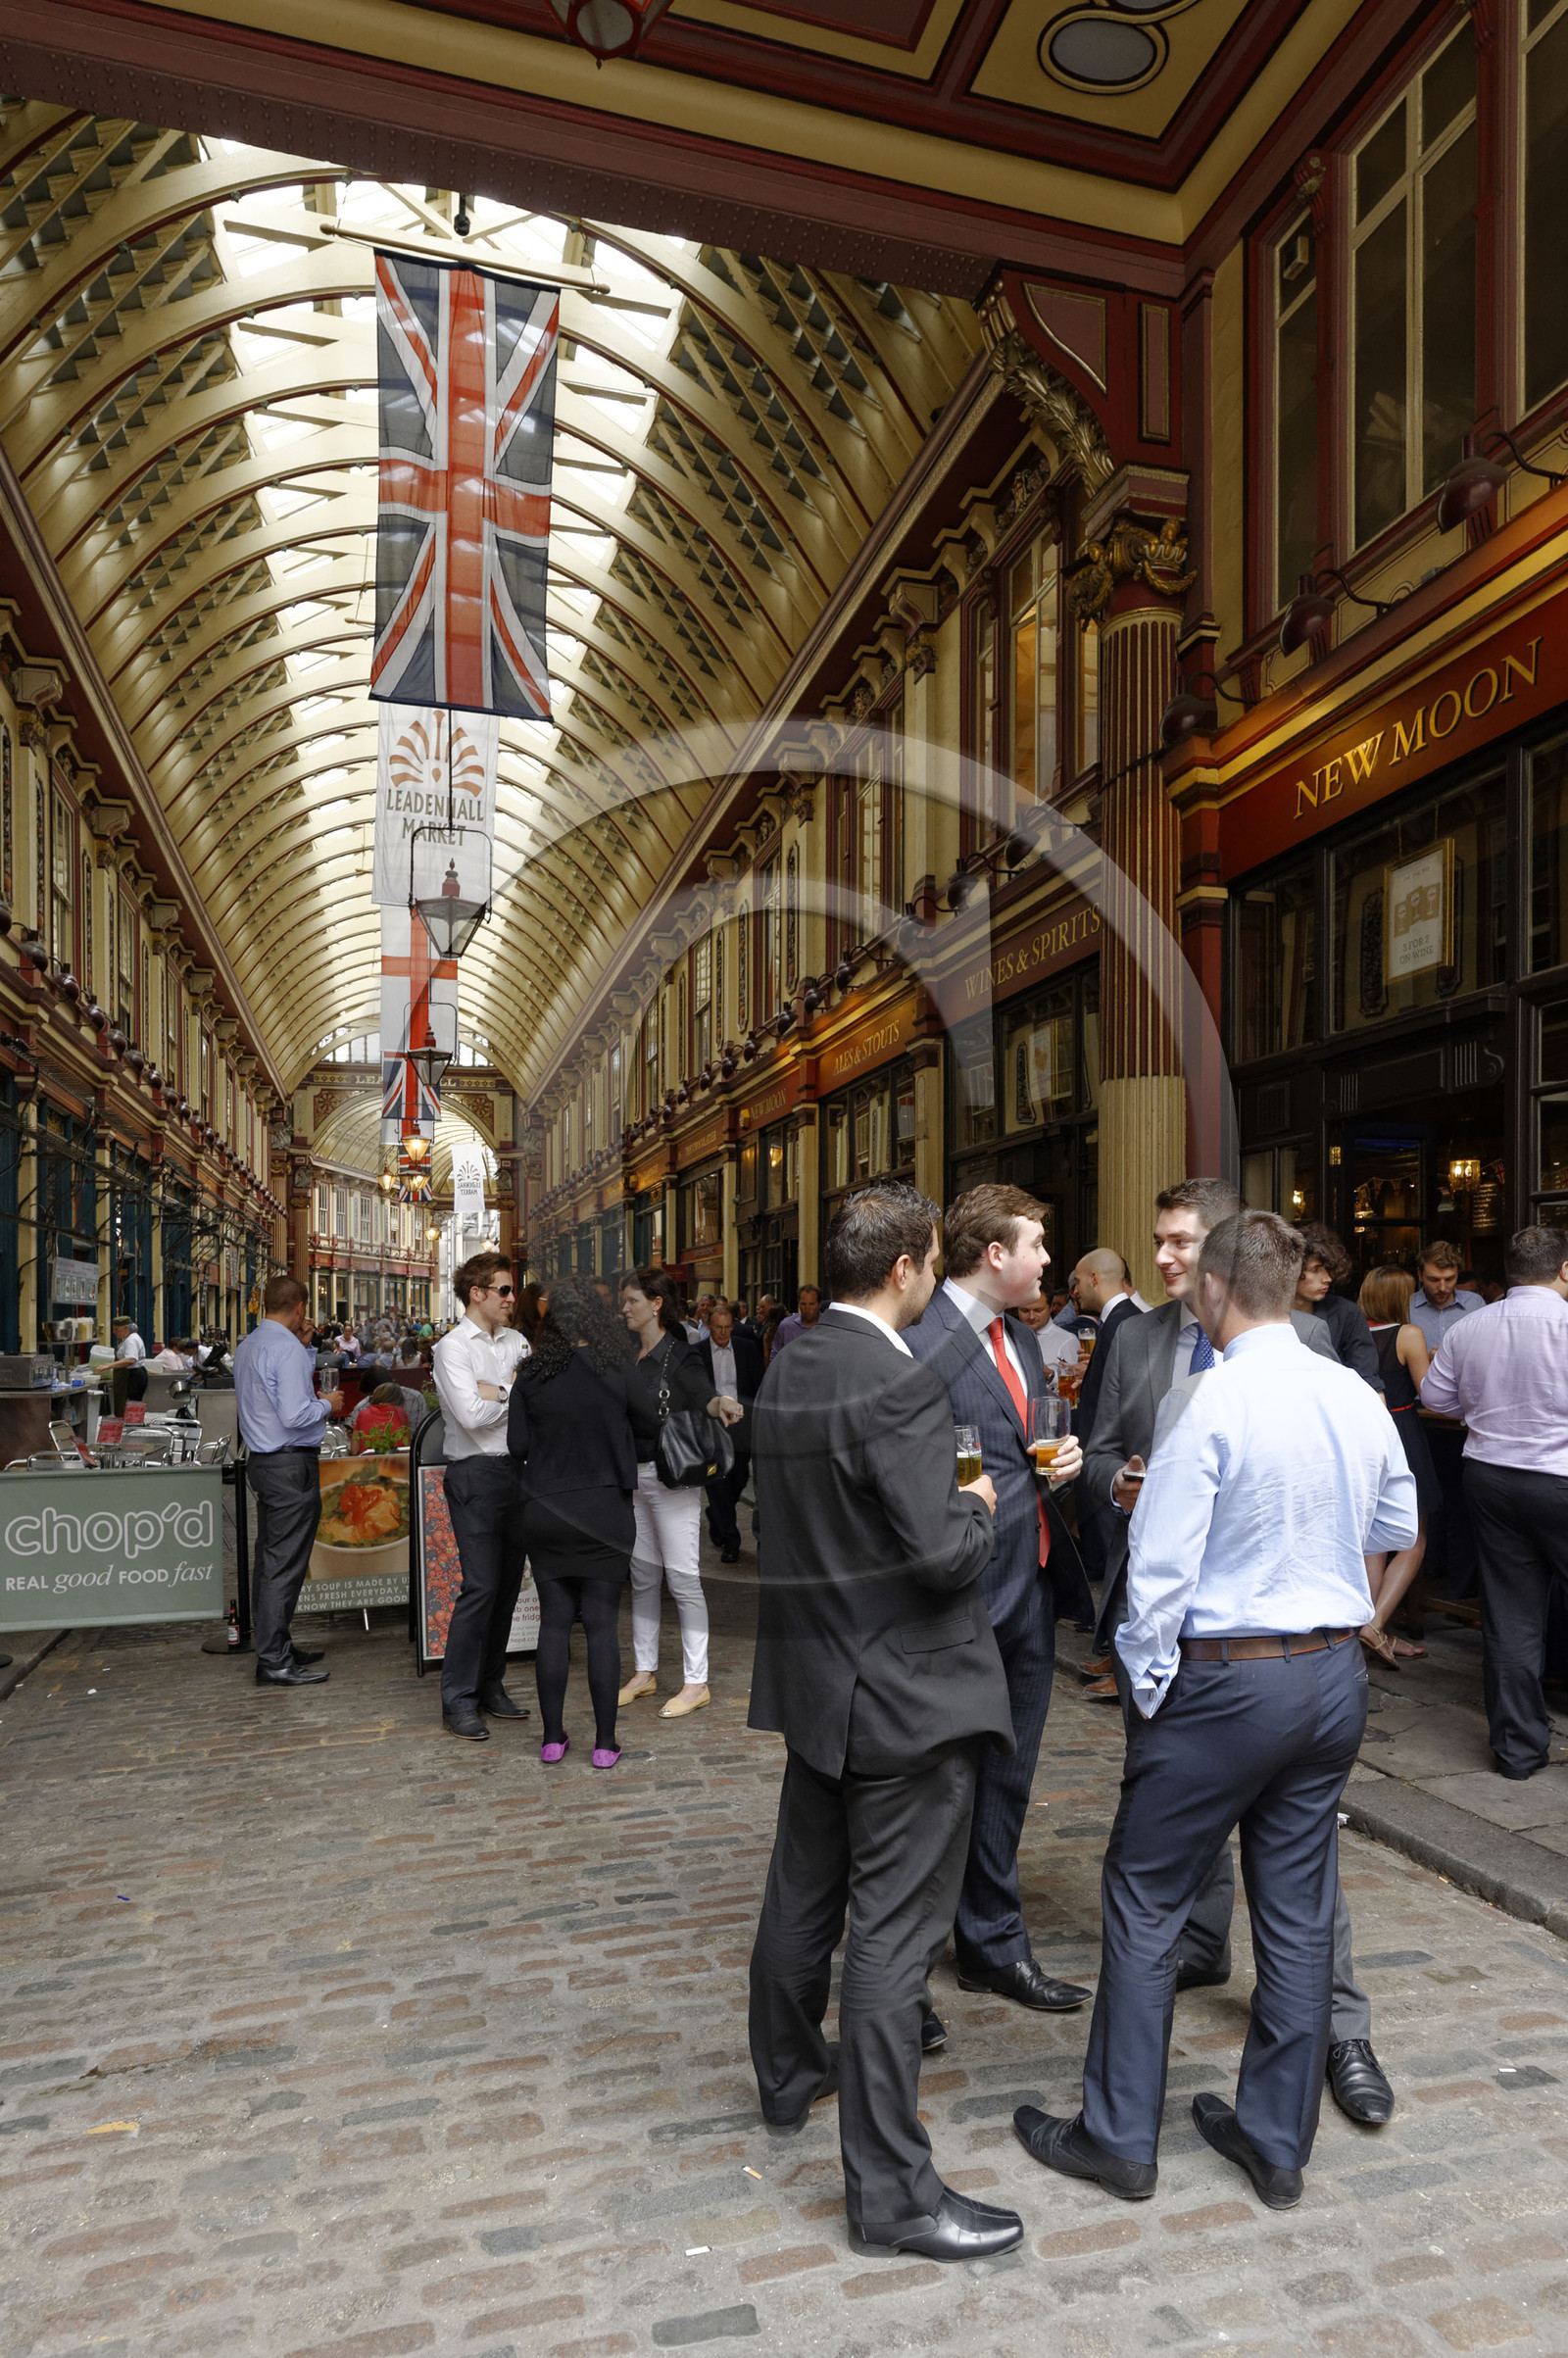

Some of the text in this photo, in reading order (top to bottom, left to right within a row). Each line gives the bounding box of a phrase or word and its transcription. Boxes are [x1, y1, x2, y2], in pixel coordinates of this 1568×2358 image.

[1294, 636, 1545, 820] NEW MOON
[386, 789, 484, 821] LEADENHALL
[402, 817, 466, 846] MARKET
[964, 902, 1101, 1001] WINES & SPIRITS
[1399, 945, 1435, 964] ON WINE
[1408, 937, 1423, 950] FOR
[1425, 934, 1430, 944] 2
[833, 1019, 901, 1075] ALES & STOUTS
[764, 1088, 787, 1115] MOON
[4, 1500, 214, 1559] chop'd
[5, 1560, 214, 1595] REAL good FOOD fast
[316, 1583, 341, 1592] SOUP
[356, 1578, 383, 1587] MADE
[386, 1576, 398, 1585] BY
[297, 1595, 408, 1612] KNOW THEY ARE GOOD
[319, 1591, 347, 1600] FRESH
[351, 1587, 403, 1597] EVERYDAY.
